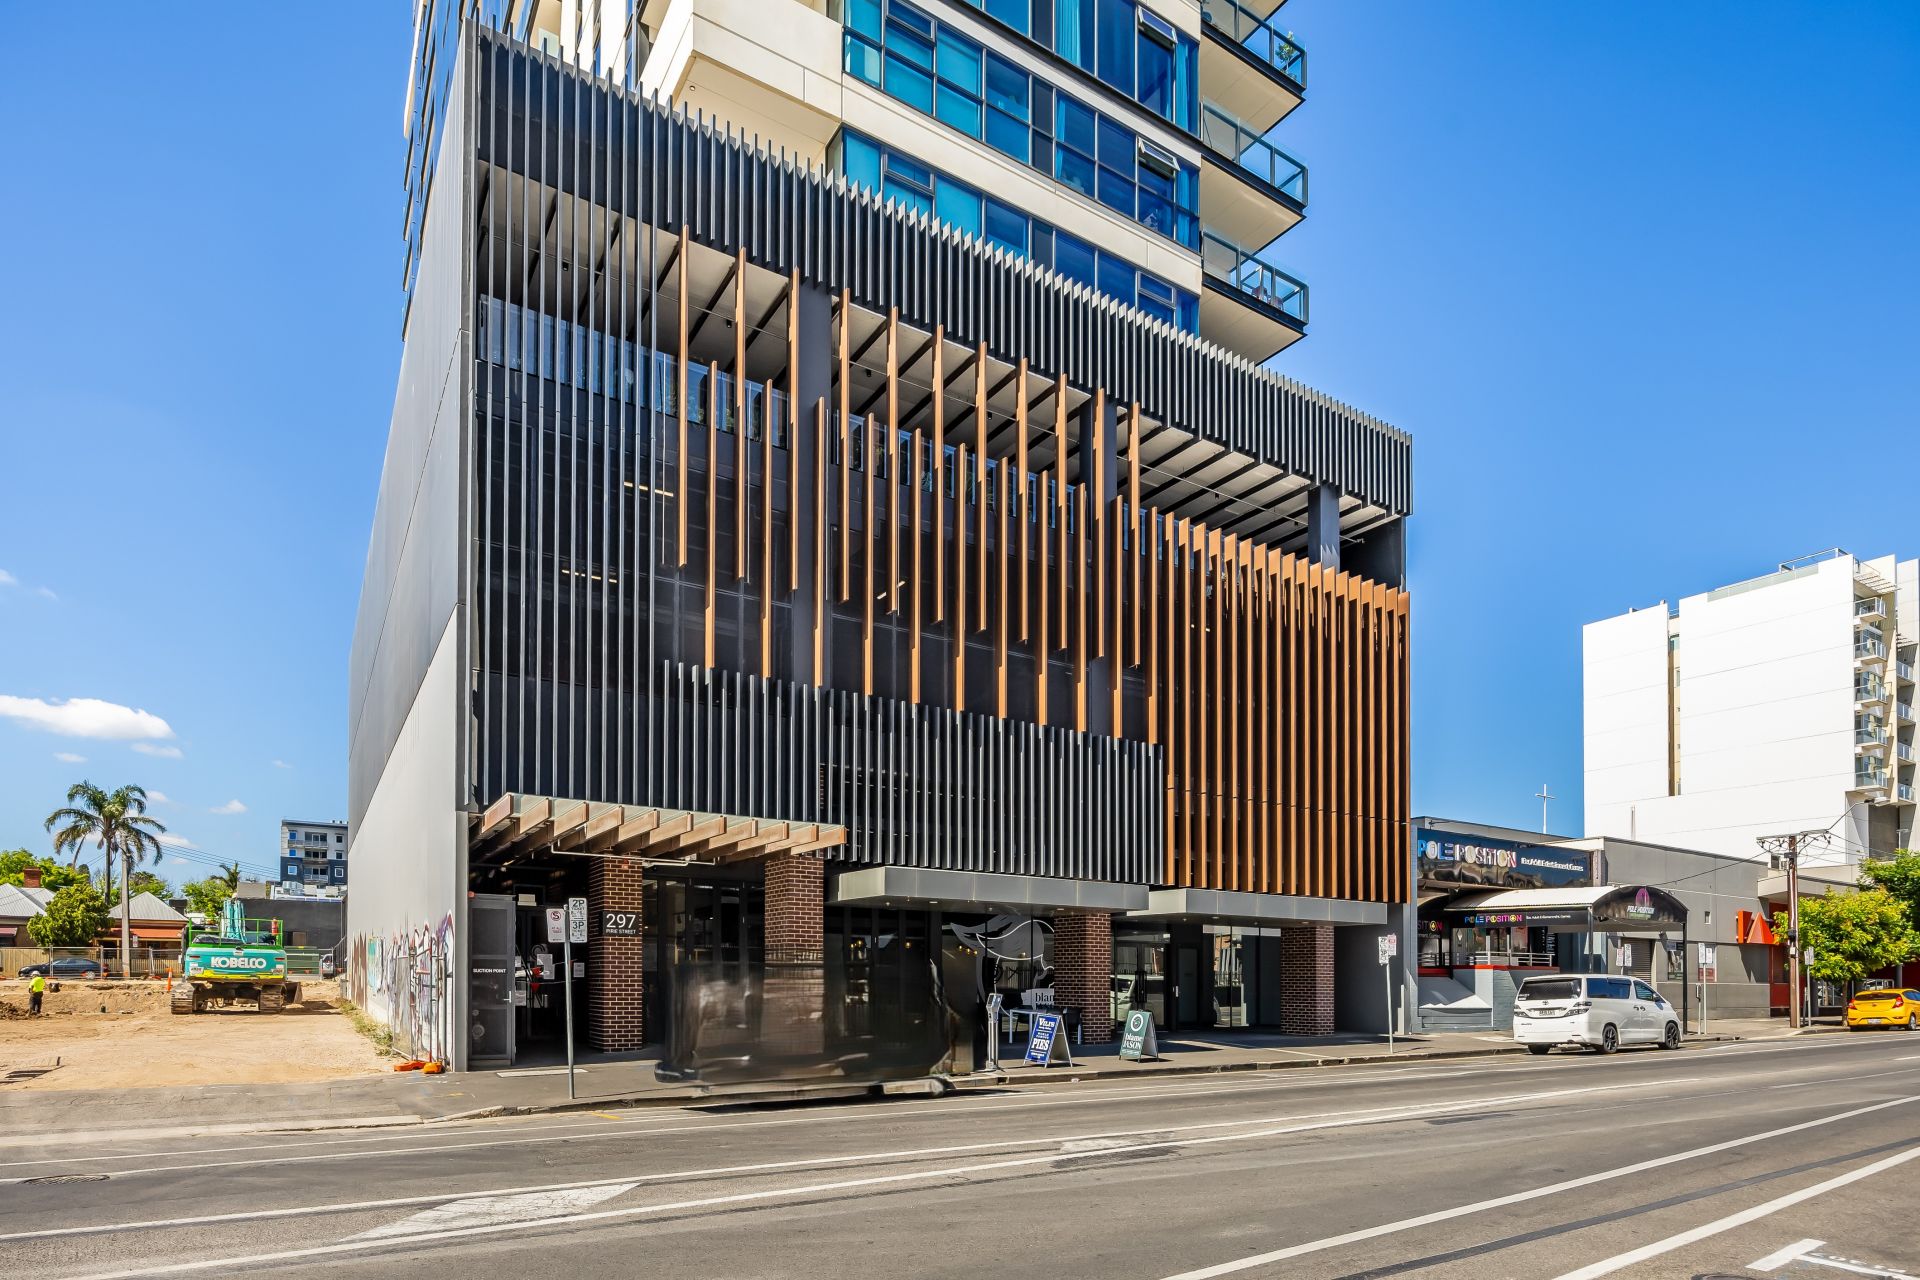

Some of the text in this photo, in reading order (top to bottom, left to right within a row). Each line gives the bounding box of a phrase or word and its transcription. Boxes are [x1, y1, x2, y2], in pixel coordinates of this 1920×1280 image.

[1417, 839, 1517, 868] POLE POSITION
[606, 913, 636, 929] 297
[1464, 914, 1522, 924] POLE POSITION
[572, 921, 585, 930] 3P
[211, 957, 266, 969] KOBELCO
[1124, 1032, 1143, 1042] blame
[1031, 1037, 1050, 1051] PIES
[1122, 1040, 1142, 1050] JASON
